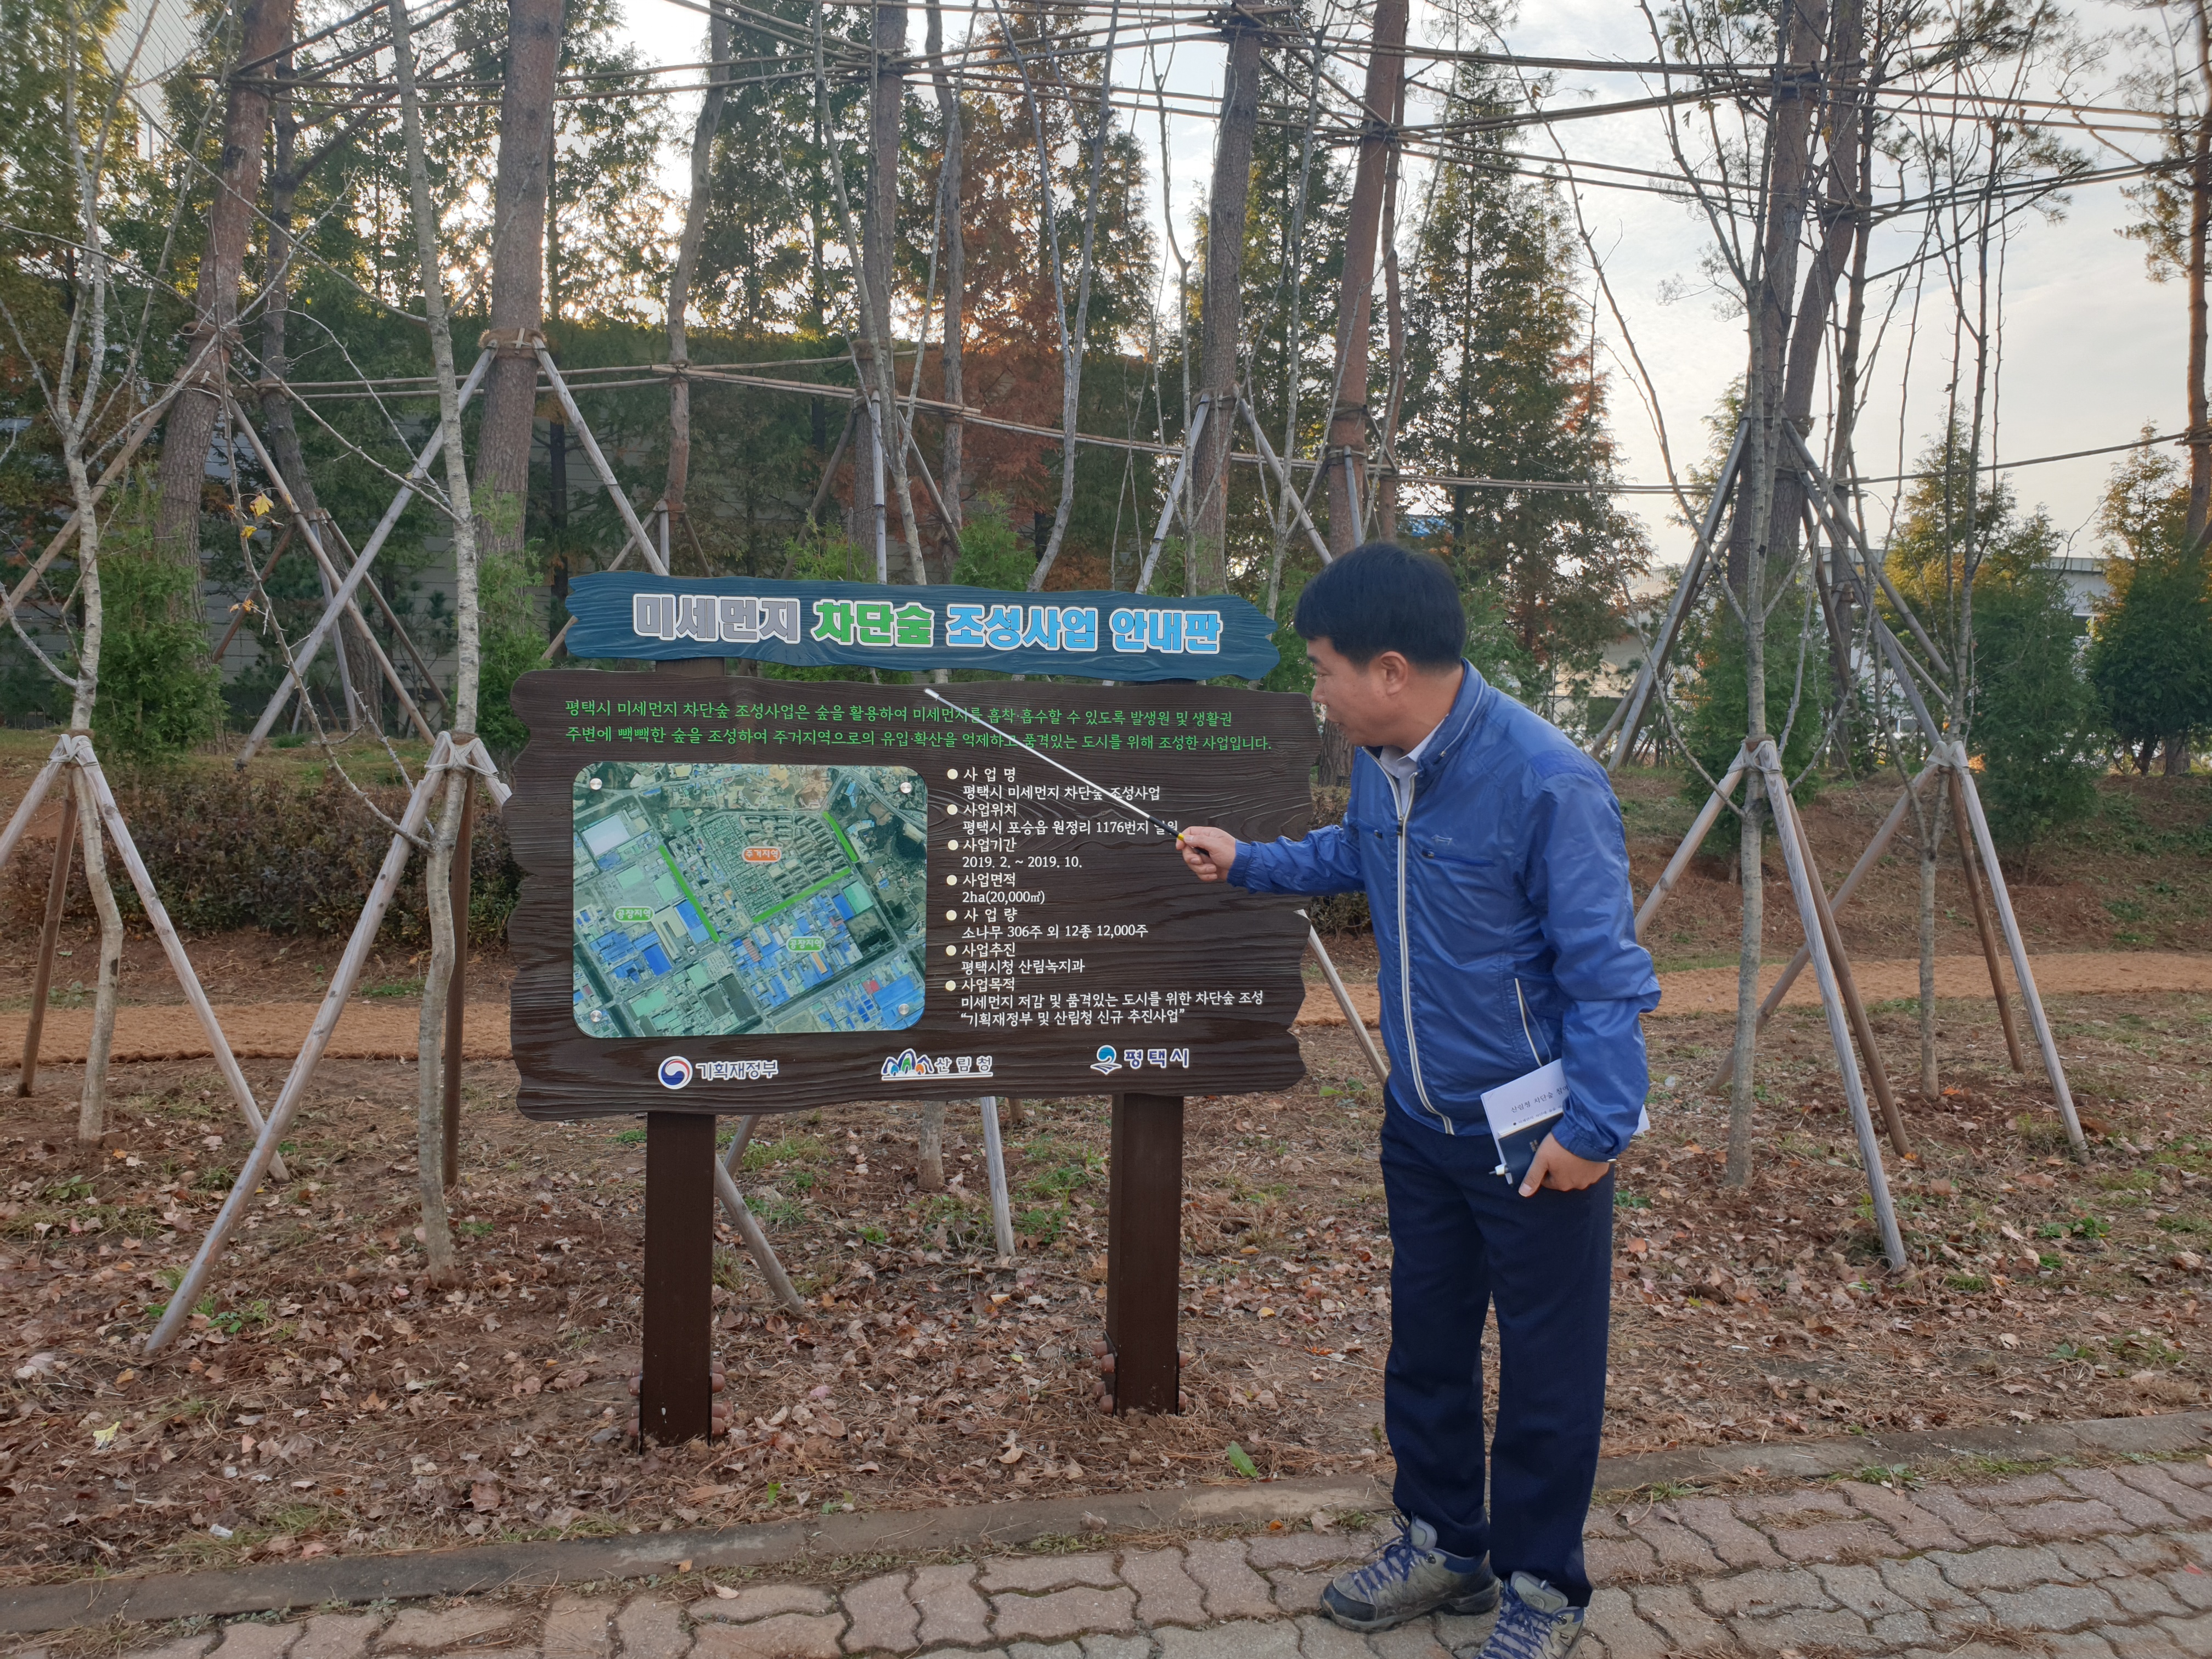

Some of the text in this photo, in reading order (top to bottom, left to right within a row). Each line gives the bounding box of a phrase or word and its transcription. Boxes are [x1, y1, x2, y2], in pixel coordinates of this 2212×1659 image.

[633, 593, 1222, 654] 미세먼지 차단숲 조성사업 안내판
[565, 699, 611, 716] 평택시
[617, 700, 678, 717] 미세먼지
[683, 702, 731, 719] 차단숲
[735, 703, 810, 720] 조성사업은
[815, 705, 845, 721] 숲을
[849, 706, 907, 722] 활용하여
[913, 706, 984, 724] 미세먼지를
[1067, 709, 1081, 725] 수
[1086, 709, 1126, 726] 있도록
[1131, 710, 1170, 727] 발생원
[1176, 710, 1188, 727] 및
[1192, 711, 1232, 727] 생활권
[566, 725, 612, 743] 주변에
[618, 726, 666, 743] 빽빽한
[671, 727, 703, 744] 숲을
[708, 729, 767, 744] 조성하여
[772, 729, 874, 747] 주거지역으로의
[962, 732, 1018, 748] 억제하고
[1023, 733, 1077, 749] 품격있는
[1081, 734, 1122, 751] 도시를
[1127, 734, 1153, 749] 위해
[1158, 735, 1199, 751] 조성한
[1202, 736, 1272, 751] 사업입니다.
[963, 785, 1160, 802] 평택시 미세먼지 차단숲 조성사업
[963, 802, 1017, 817] 사업위치
[962, 820, 1002, 836] 평택시
[1007, 820, 1049, 836] 포승읍
[1051, 820, 1091, 836] 원정리
[1096, 820, 1149, 836] 1176번지
[963, 837, 1017, 853] 사업기간
[746, 849, 778, 859] 주거지역
[962, 856, 996, 868] 2019.
[999, 856, 1011, 868] 2.
[1027, 856, 1060, 868] 2019.
[1064, 856, 1082, 868] 10.
[962, 872, 1015, 888] 사업면적
[617, 909, 651, 919] 공장지역
[961, 924, 1149, 940] 소나무 306주 외 12종 12,000주
[790, 939, 822, 949] 공장지역
[962, 941, 1015, 958] 사업추진
[961, 958, 1086, 975] 평택시청 산림녹지과
[961, 977, 1015, 993] 사업목적
[961, 989, 1263, 1010] 미세먼지 저감 및 품격있는 도시를 위한 차단숲 조성
[1037, 1011, 1049, 1026] 및
[1054, 1009, 1092, 1026] 산림청
[1097, 1009, 1124, 1025] 신규
[933, 1056, 993, 1074] 산림청
[1123, 1048, 1189, 1069] 평택시
[695, 1059, 779, 1081] 기획재정부
[1511, 1101, 1531, 1113] 산림청
[1534, 1091, 1554, 1104] 차단숲
